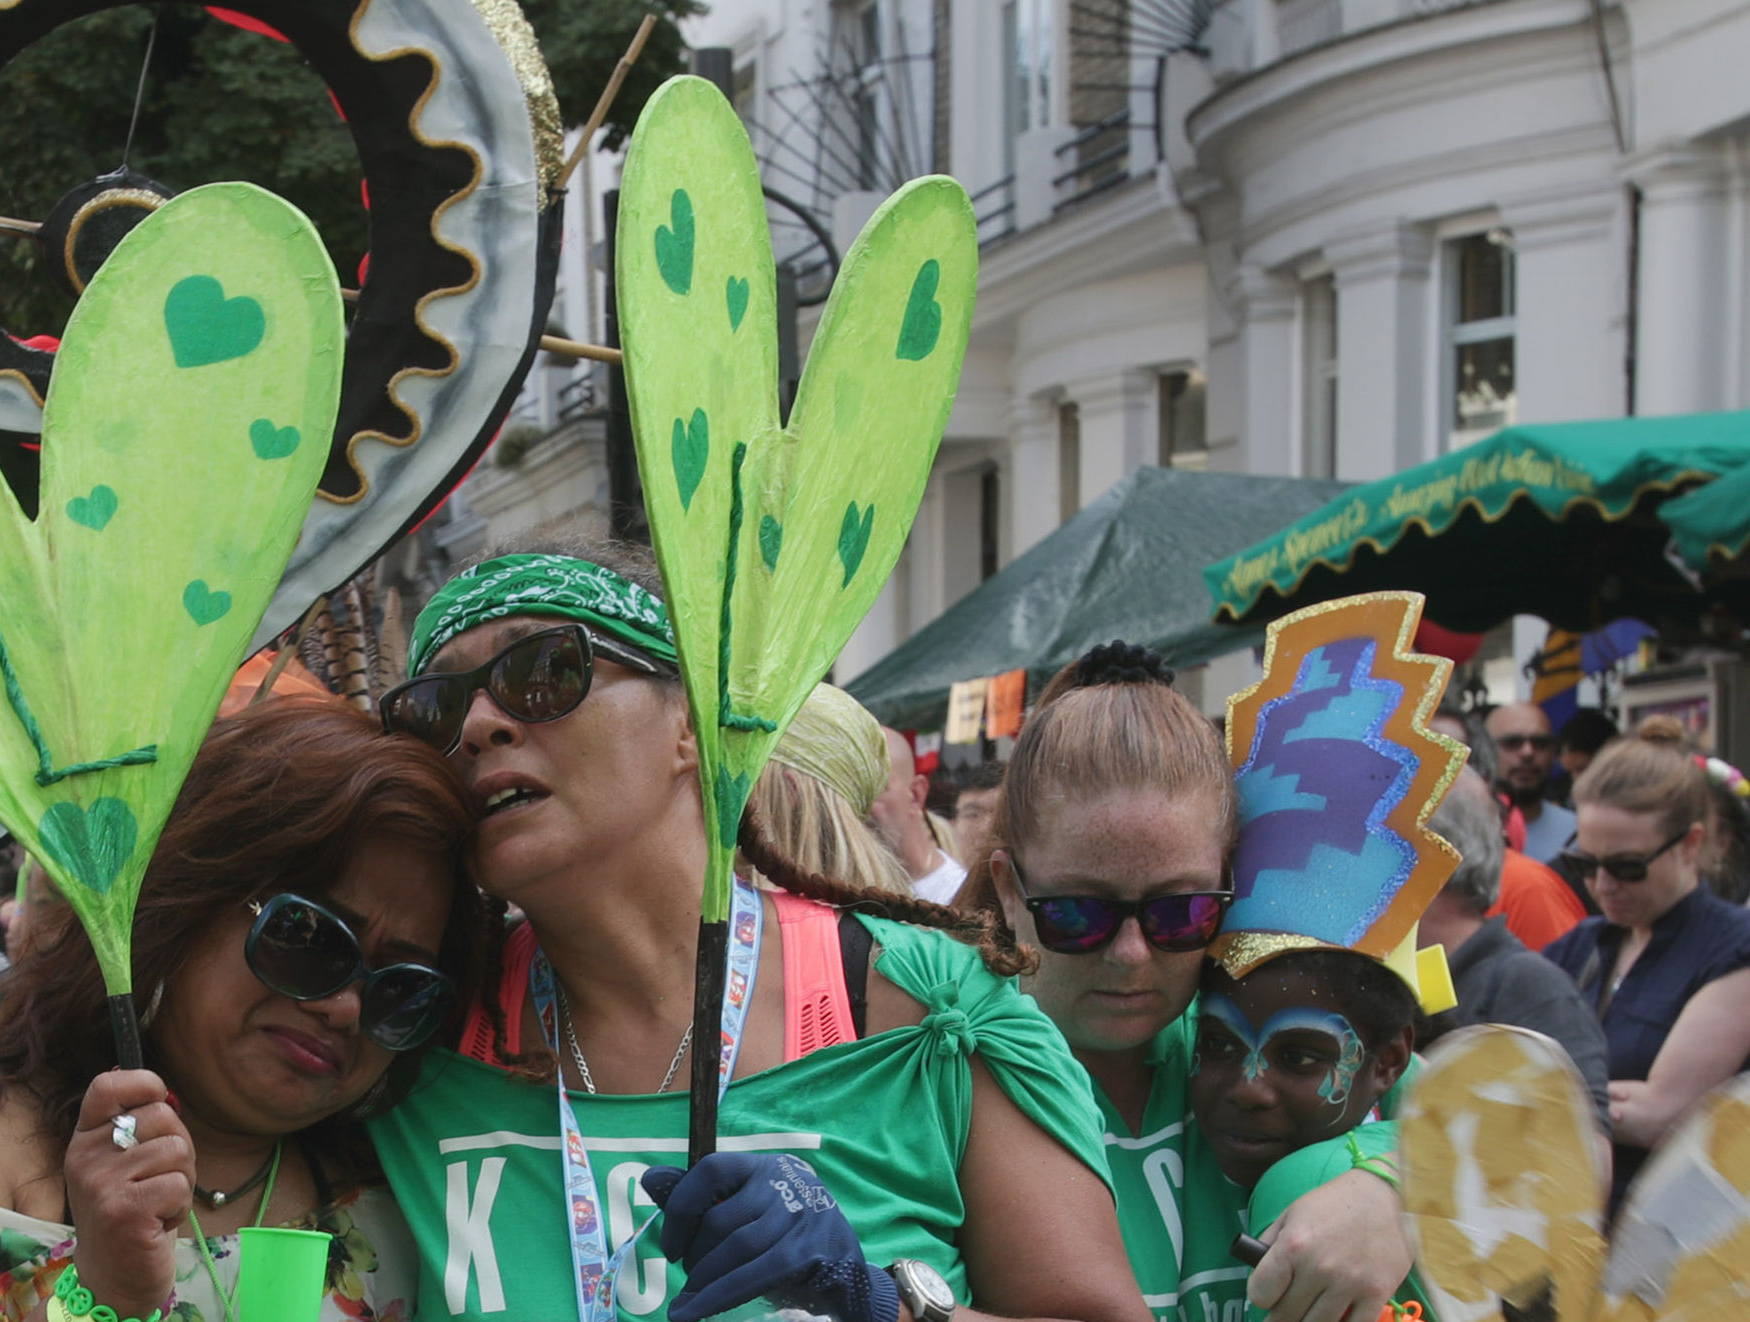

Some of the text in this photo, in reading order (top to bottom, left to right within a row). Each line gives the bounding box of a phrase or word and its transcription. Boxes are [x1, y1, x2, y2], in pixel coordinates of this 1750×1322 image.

[444, 1157, 668, 1315] K C
[774, 1180, 804, 1213] arco
